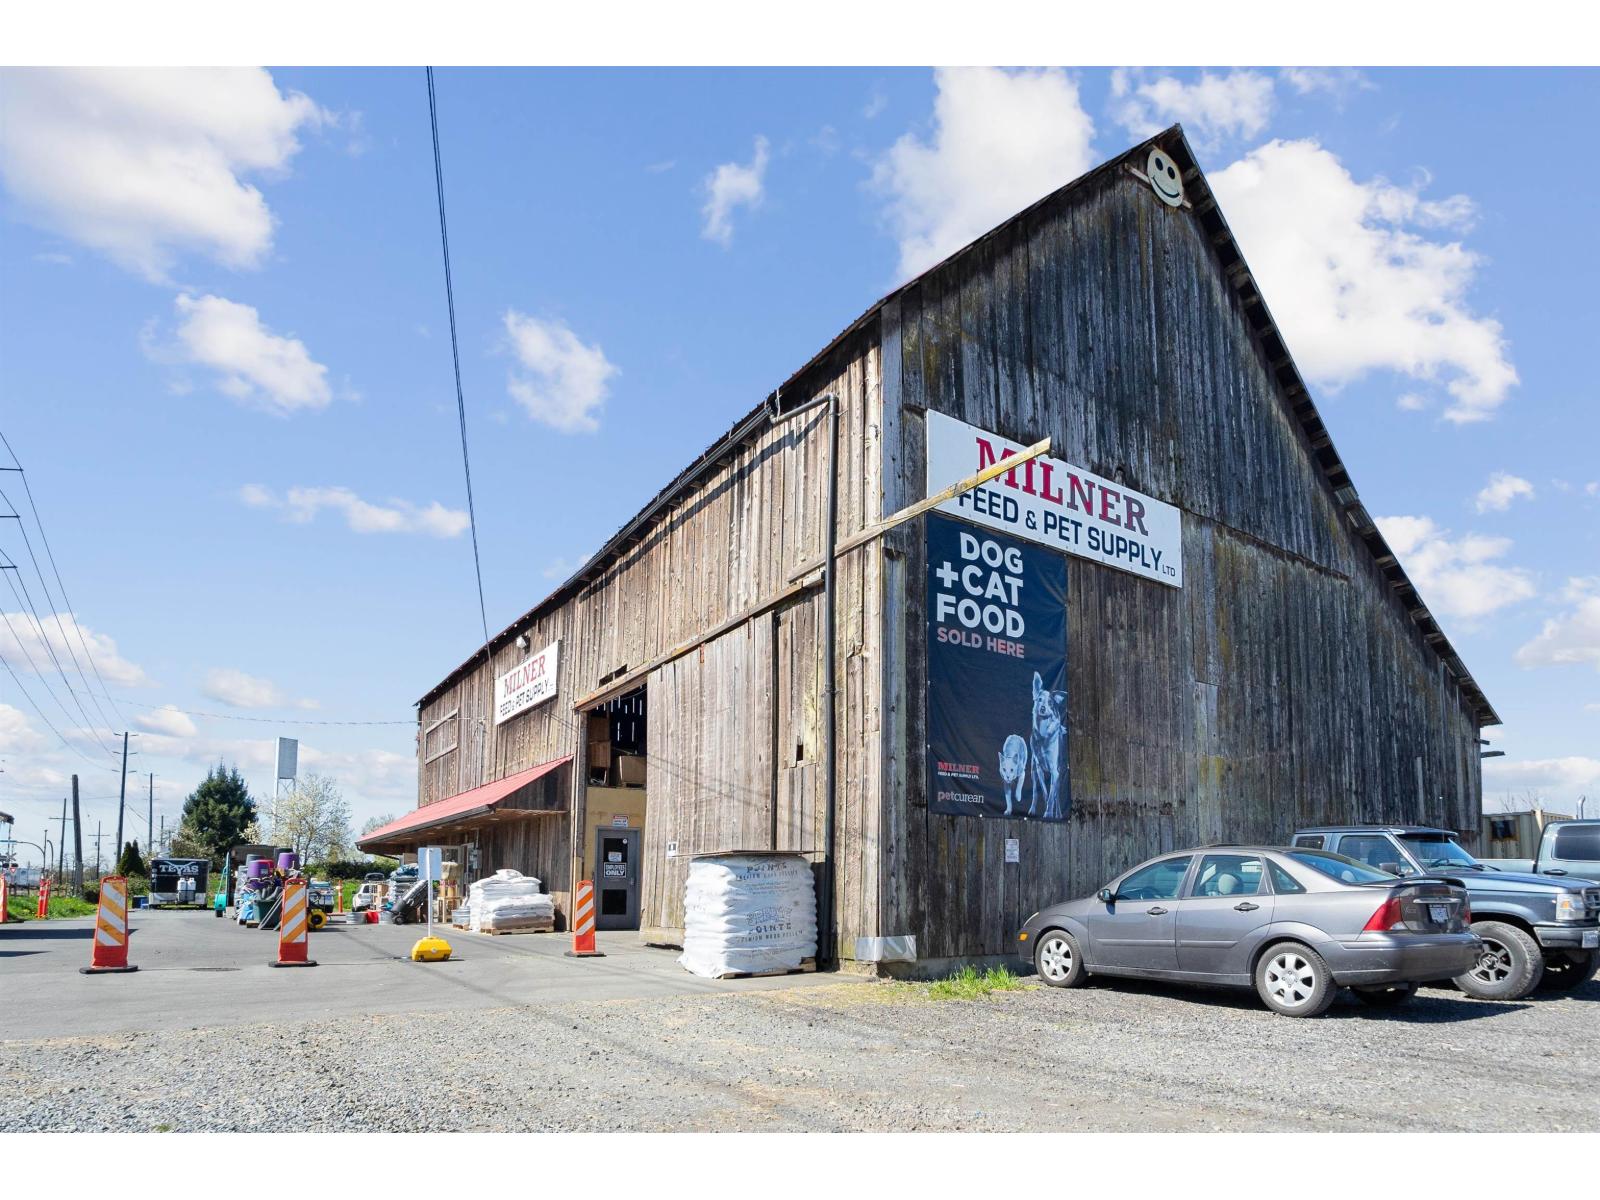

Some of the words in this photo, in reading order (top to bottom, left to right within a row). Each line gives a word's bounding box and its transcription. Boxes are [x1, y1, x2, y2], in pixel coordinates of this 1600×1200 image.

[976, 437, 1149, 536] MILNER
[960, 532, 1024, 574] DOG
[1025, 510, 1037, 530] &
[1043, 510, 1082, 544] PET
[1088, 527, 1162, 571] SUPPLY
[1162, 564, 1176, 577] LTD
[937, 593, 1025, 638] FOOD
[937, 627, 982, 649] SOLD
[987, 636, 1025, 658] HERE
[504, 655, 545, 698] MILNER
[938, 761, 980, 774] MILNER
[938, 791, 984, 804] petcurean
